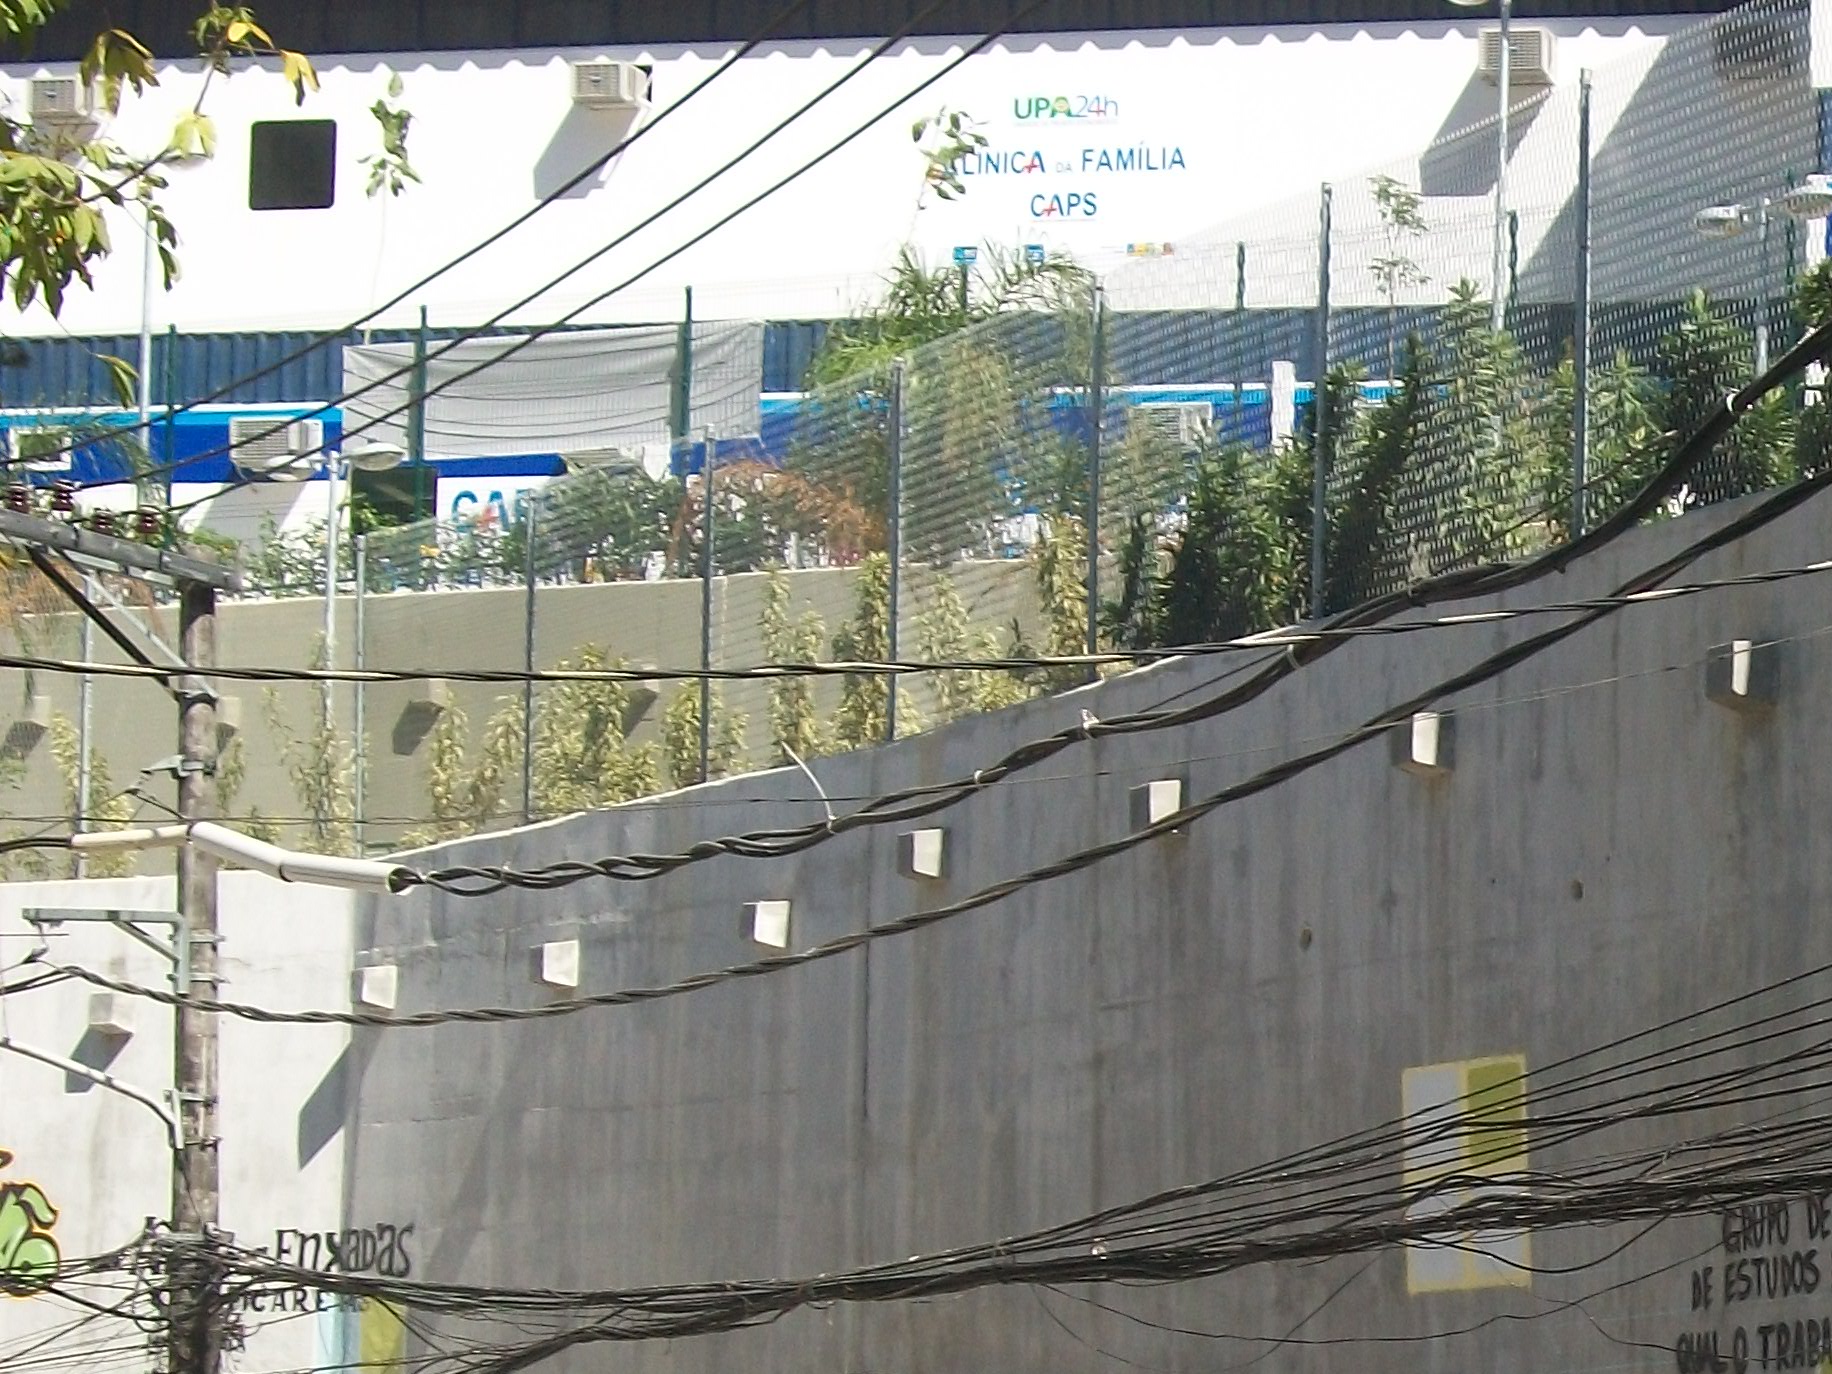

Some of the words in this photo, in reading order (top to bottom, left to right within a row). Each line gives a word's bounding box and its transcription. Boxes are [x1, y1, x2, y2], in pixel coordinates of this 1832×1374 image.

[1081, 140, 1187, 173] FAMÍLIA
[1030, 192, 1098, 217] CAPS
[1806, 1194, 1832, 1241] DE
[1690, 1266, 1714, 1312] DE
[1724, 1248, 1821, 1304] ESTUDOS
